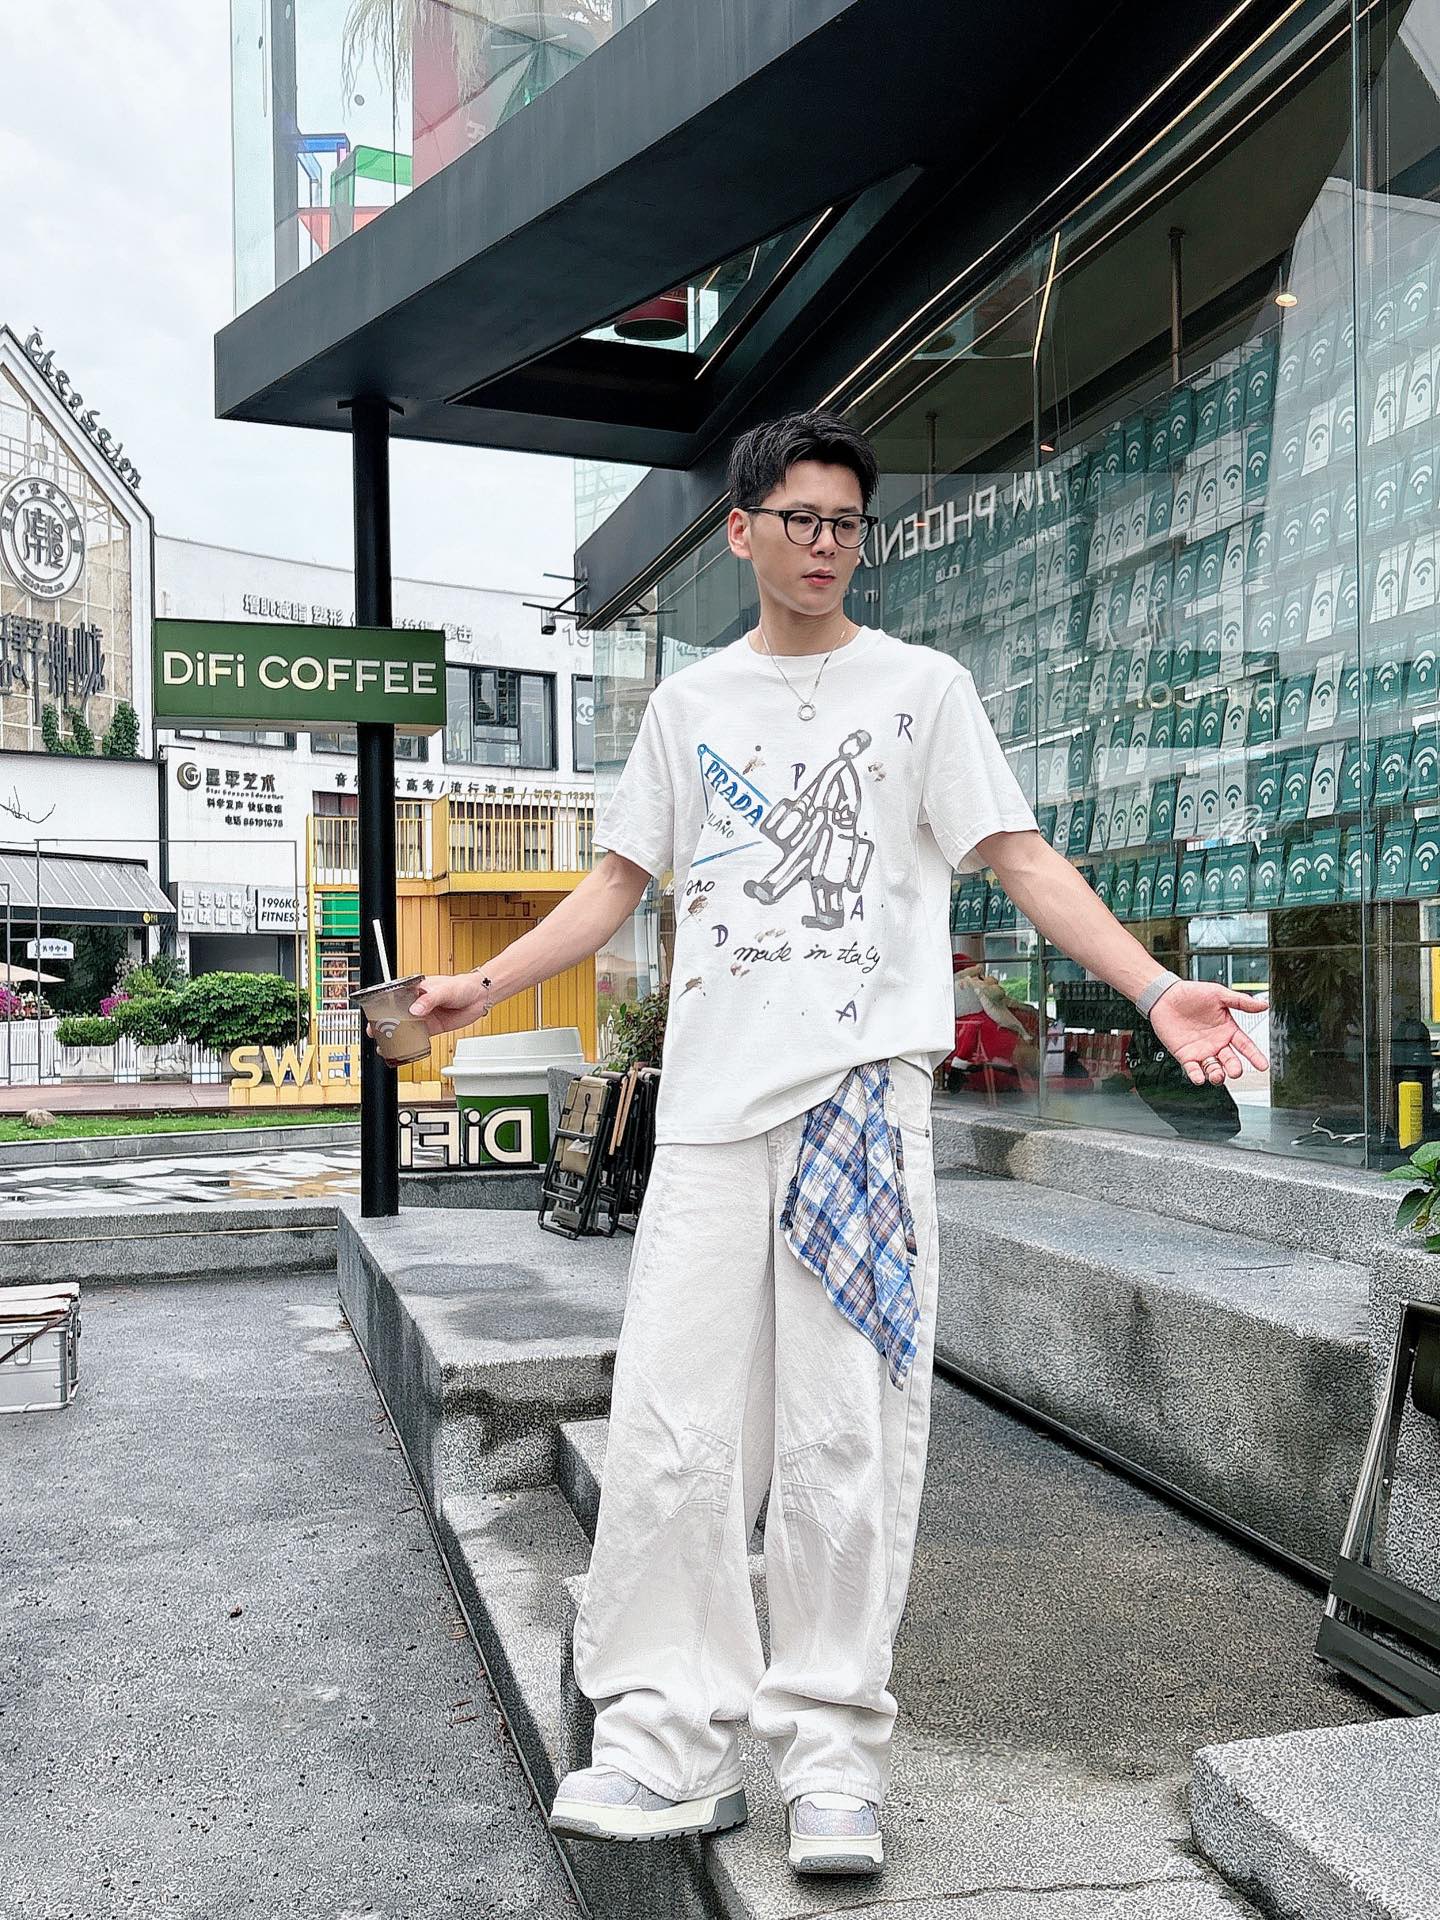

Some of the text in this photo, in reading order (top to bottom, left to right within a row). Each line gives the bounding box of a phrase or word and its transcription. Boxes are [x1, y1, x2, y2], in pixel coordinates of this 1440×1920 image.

[162, 650, 438, 694] DiFi COFFEE
[894, 713, 913, 744] R
[791, 763, 806, 791] P
[704, 759, 764, 828] PRADA
[261, 897, 300, 910] 1996KG
[850, 895, 864, 921] A
[261, 911, 300, 924] FITNESS
[711, 924, 729, 948] D
[733, 941, 792, 963] made
[804, 944, 832, 960] in
[836, 1000, 857, 1023] A
